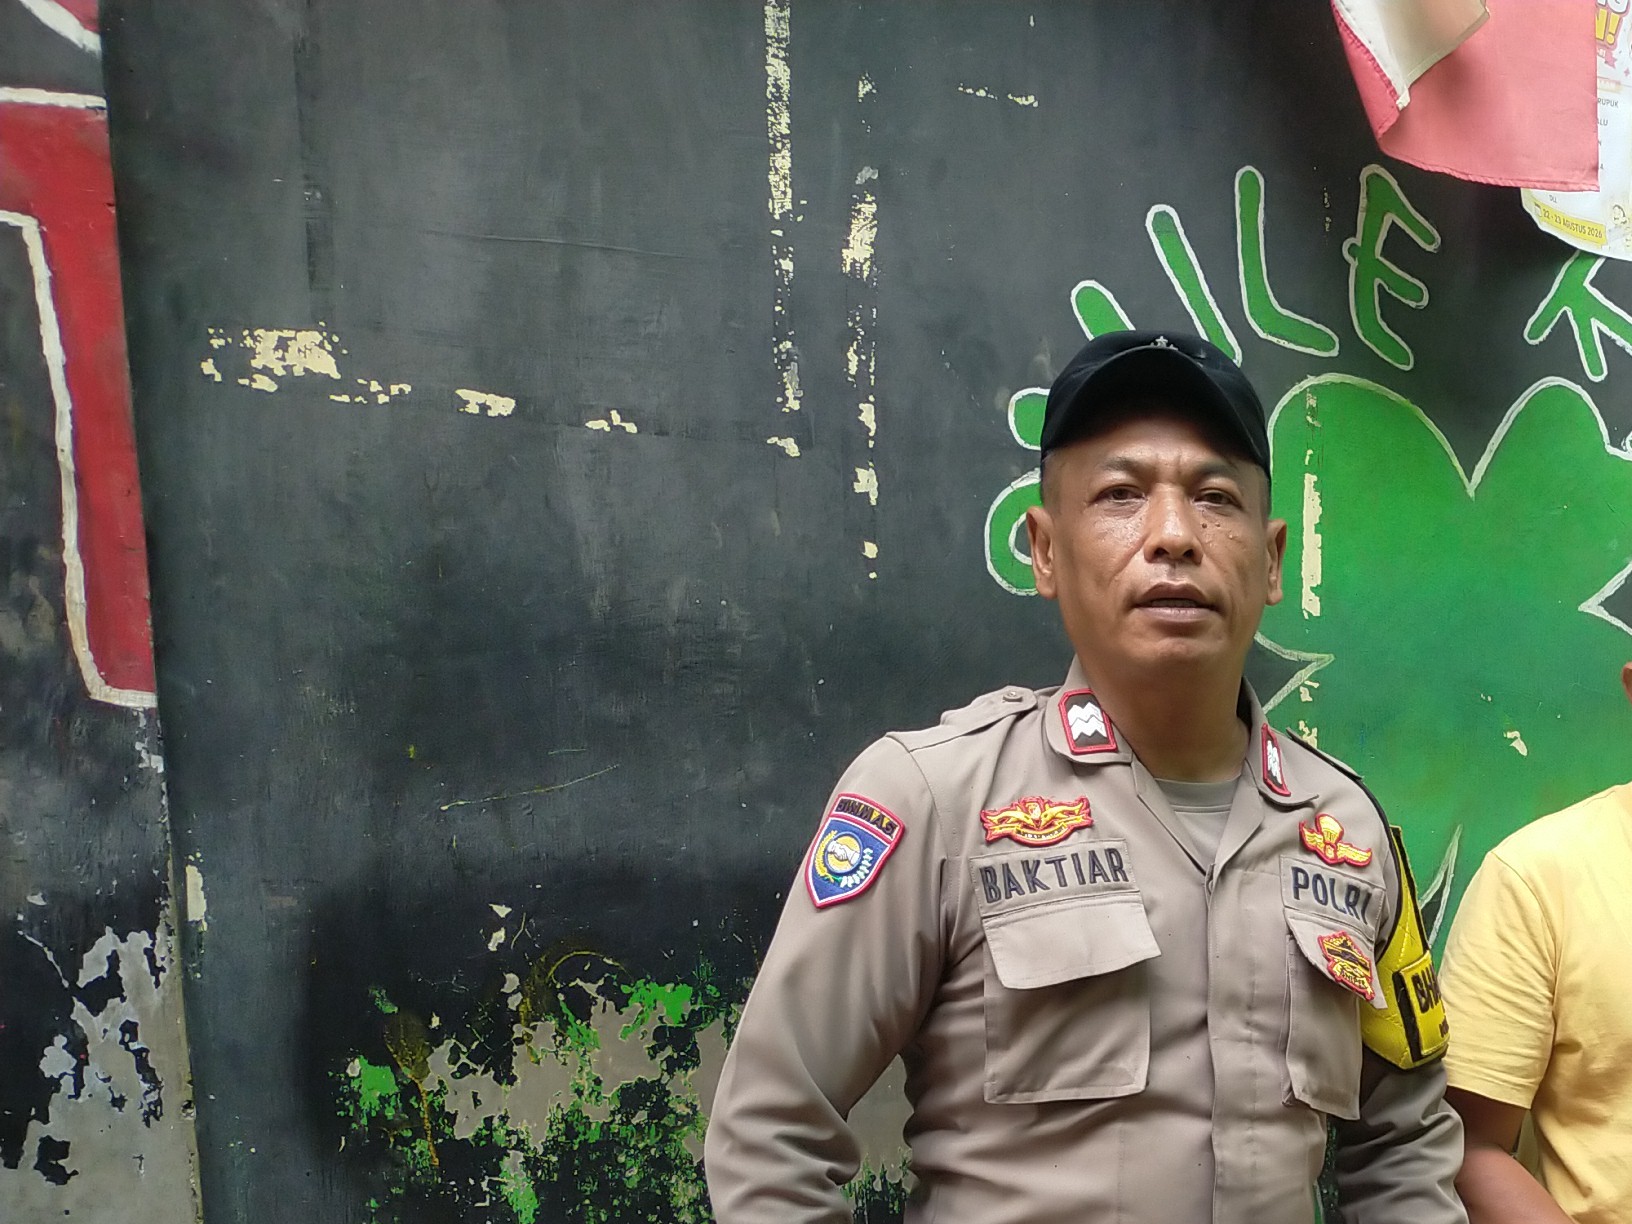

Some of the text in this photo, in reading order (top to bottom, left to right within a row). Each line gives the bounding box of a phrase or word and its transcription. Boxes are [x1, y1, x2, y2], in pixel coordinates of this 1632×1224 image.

[1543, 208, 1551, 218] 22
[1555, 214, 1562, 225] 23
[1562, 220, 1587, 235] AGUSTUS
[1587, 226, 1603, 240] 2026
[979, 847, 1130, 904] BAKTIAR
[1291, 866, 1373, 926] POLRI
